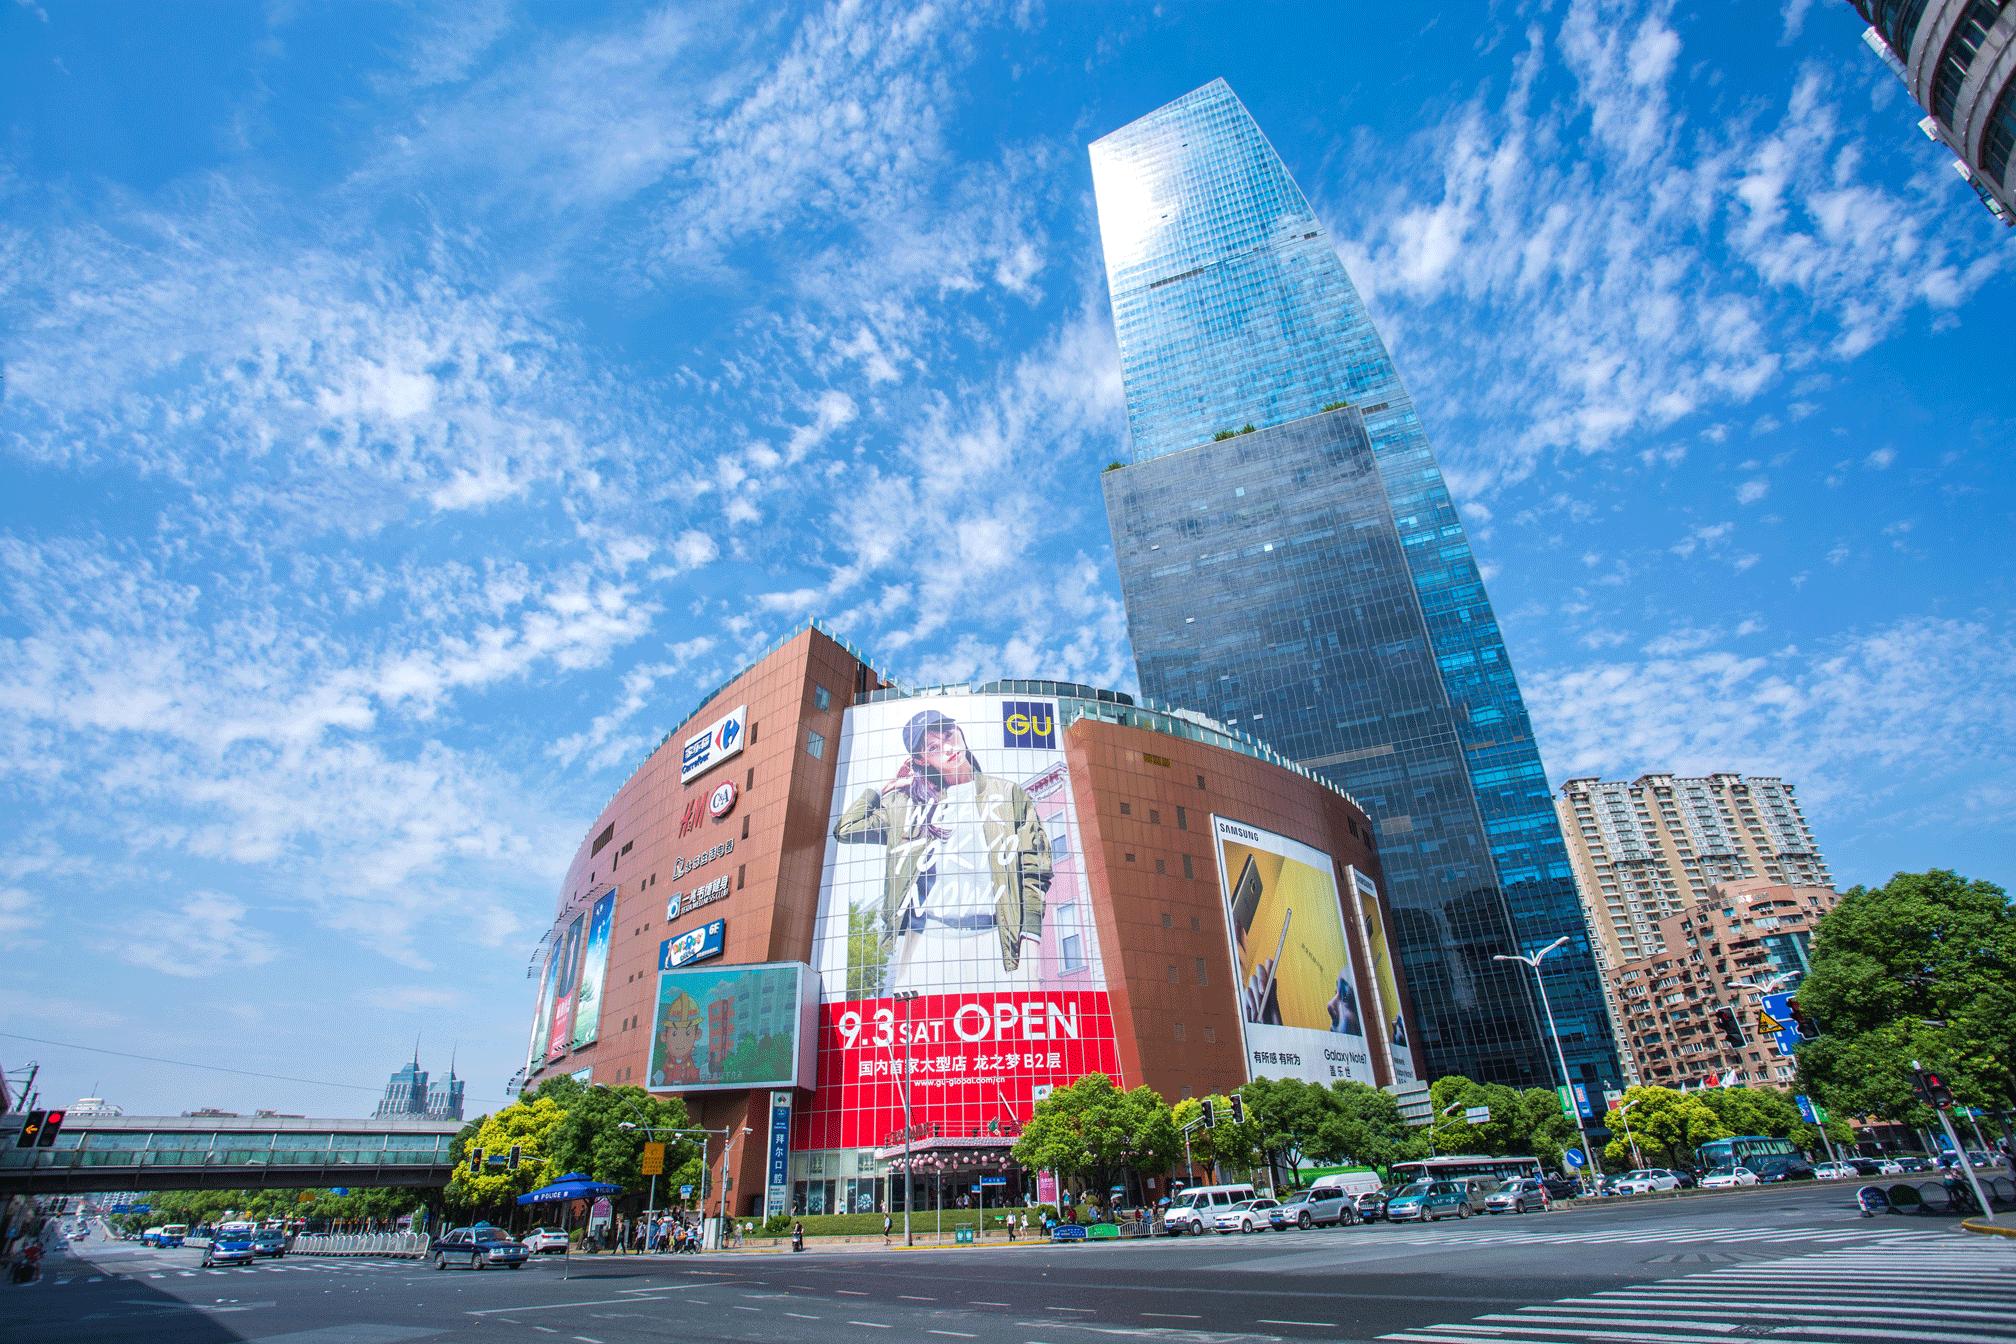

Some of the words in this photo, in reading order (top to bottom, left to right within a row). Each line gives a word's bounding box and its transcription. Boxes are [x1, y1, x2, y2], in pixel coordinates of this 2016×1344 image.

[1007, 713, 1052, 737] GU
[1219, 823, 1259, 842] SAMSUNG
[890, 834, 1019, 875] TOKYO
[839, 1008, 894, 1049] 9.3
[899, 1021, 944, 1044] SAT
[953, 1002, 1078, 1042] OPEN
[859, 1055, 967, 1077] 国内首家大型店
[1253, 1050, 1278, 1064] 有所感
[1324, 1048, 1350, 1064] Galaxy
[773, 1133, 785, 1184] 拜尔口腔
[541, 1191, 561, 1200] POLICE
